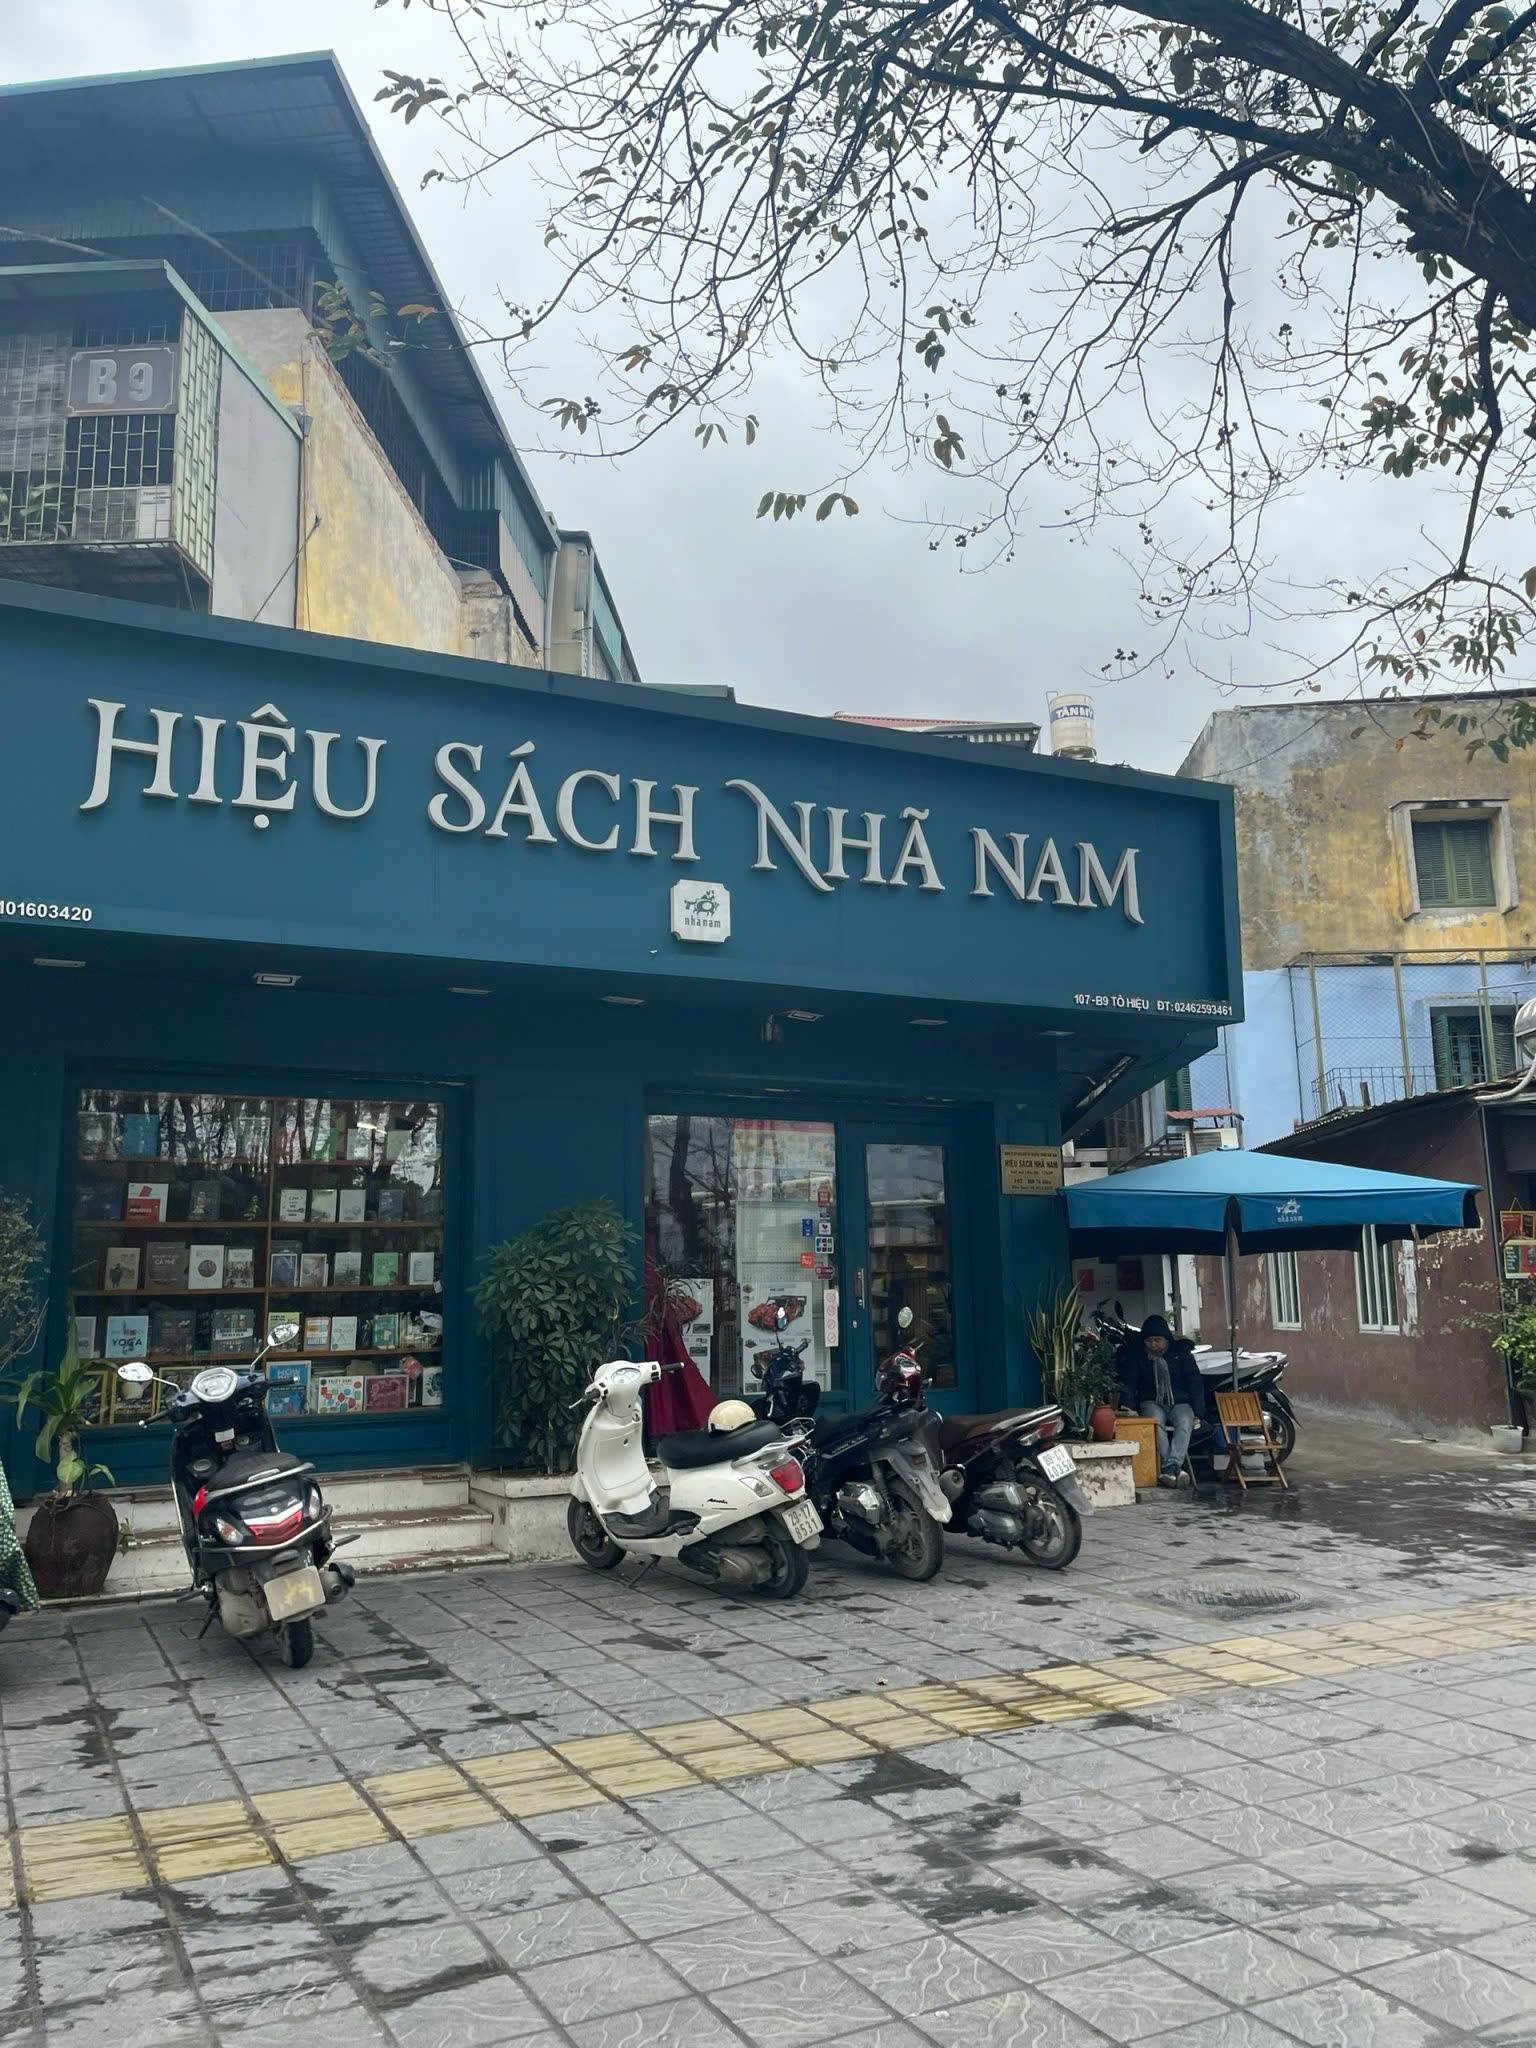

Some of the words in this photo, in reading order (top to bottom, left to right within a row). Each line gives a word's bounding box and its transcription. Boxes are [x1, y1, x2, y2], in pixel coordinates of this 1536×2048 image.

[80, 697, 388, 830] HIỆU
[427, 740, 701, 862] SÁCH
[724, 777, 946, 892] NHÃ
[967, 826, 1145, 925] NAM
[112, 1337, 142, 1347] YOGA
